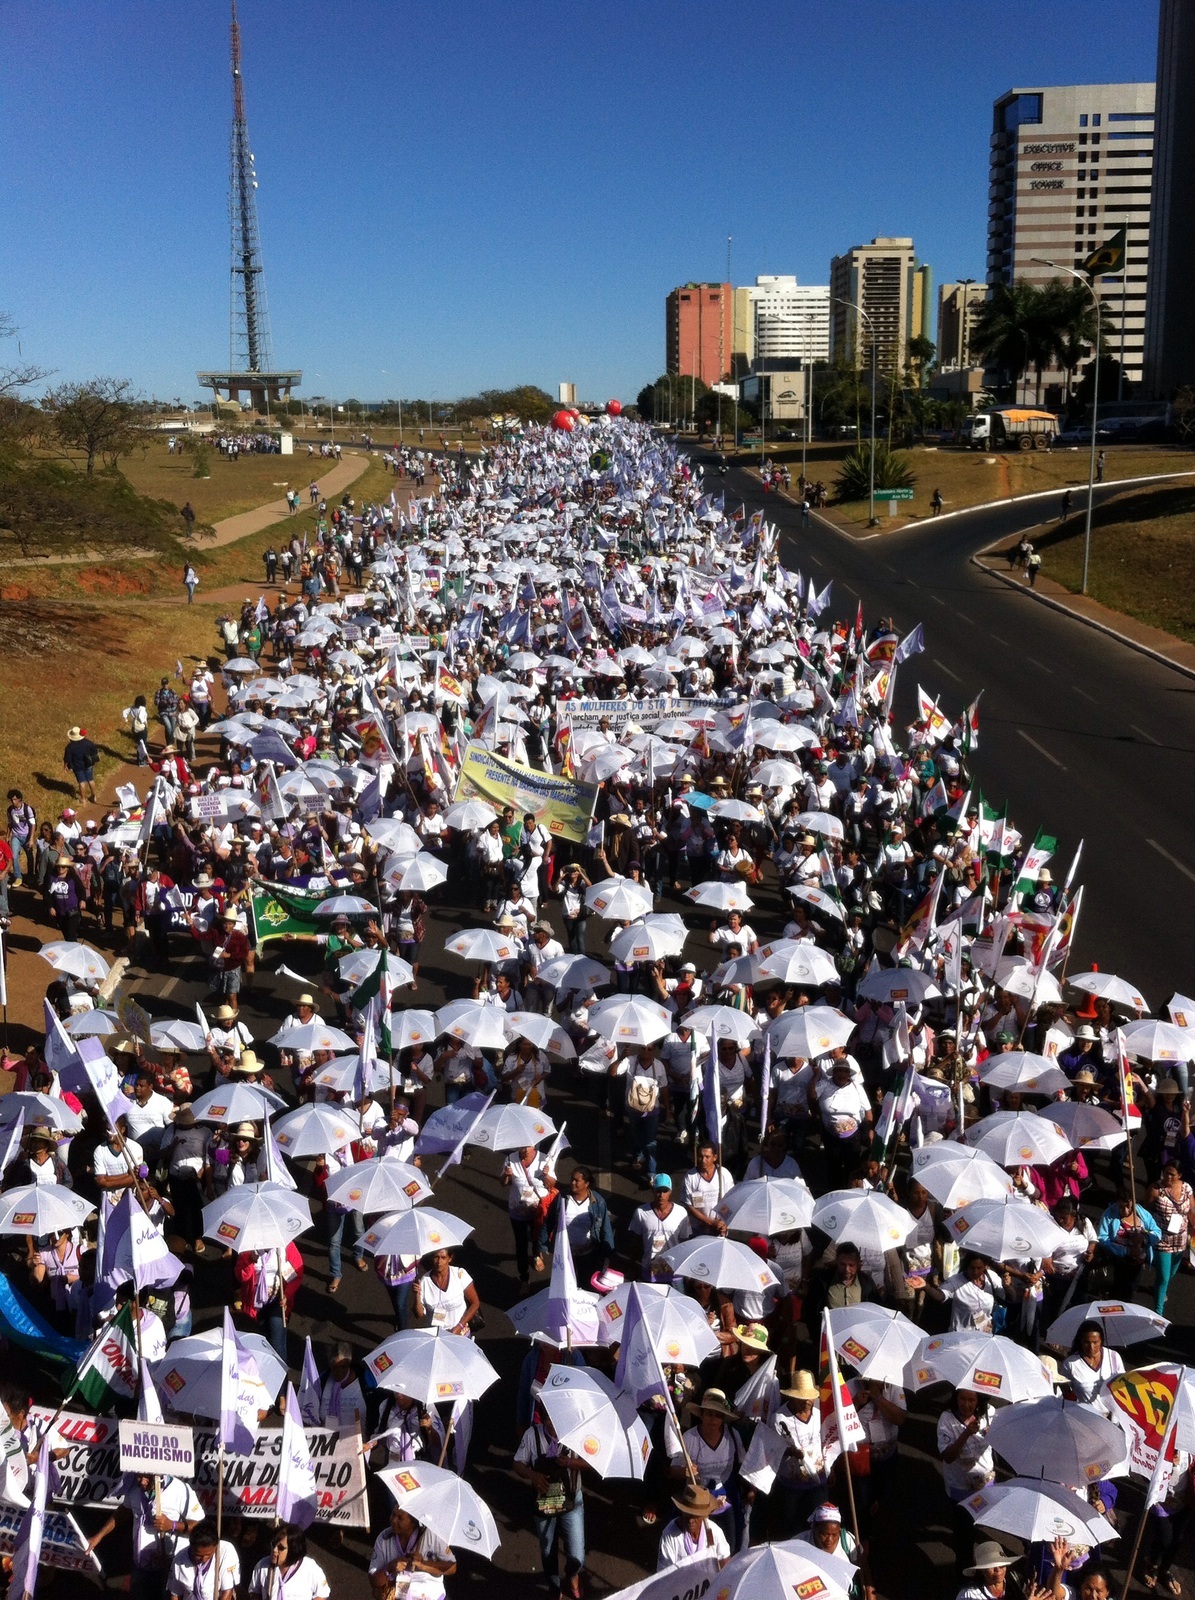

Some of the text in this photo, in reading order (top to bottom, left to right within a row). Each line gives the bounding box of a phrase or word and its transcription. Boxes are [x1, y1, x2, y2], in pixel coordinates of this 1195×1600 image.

[1023, 143, 1076, 154] EXECUTIVE
[1031, 161, 1064, 171] OFFICE
[1030, 180, 1064, 190] TOWER
[565, 702, 576, 711] AS
[581, 702, 627, 712] MULHERES
[632, 701, 643, 710] DO
[648, 700, 666, 711] STR
[617, 711, 639, 724] justiça
[15, 1214, 35, 1223] CTB
[219, 1223, 238, 1239] CTB
[845, 1341, 866, 1361] CTB
[376, 1355, 391, 1371] CTB
[975, 1371, 1001, 1387] CTB
[133, 1430, 159, 1447] NÃO
[162, 1435, 179, 1449] AO
[121, 1443, 193, 1464] MACHISMO
[399, 1472, 418, 1491] CTB
[797, 1580, 824, 1599] CTB
